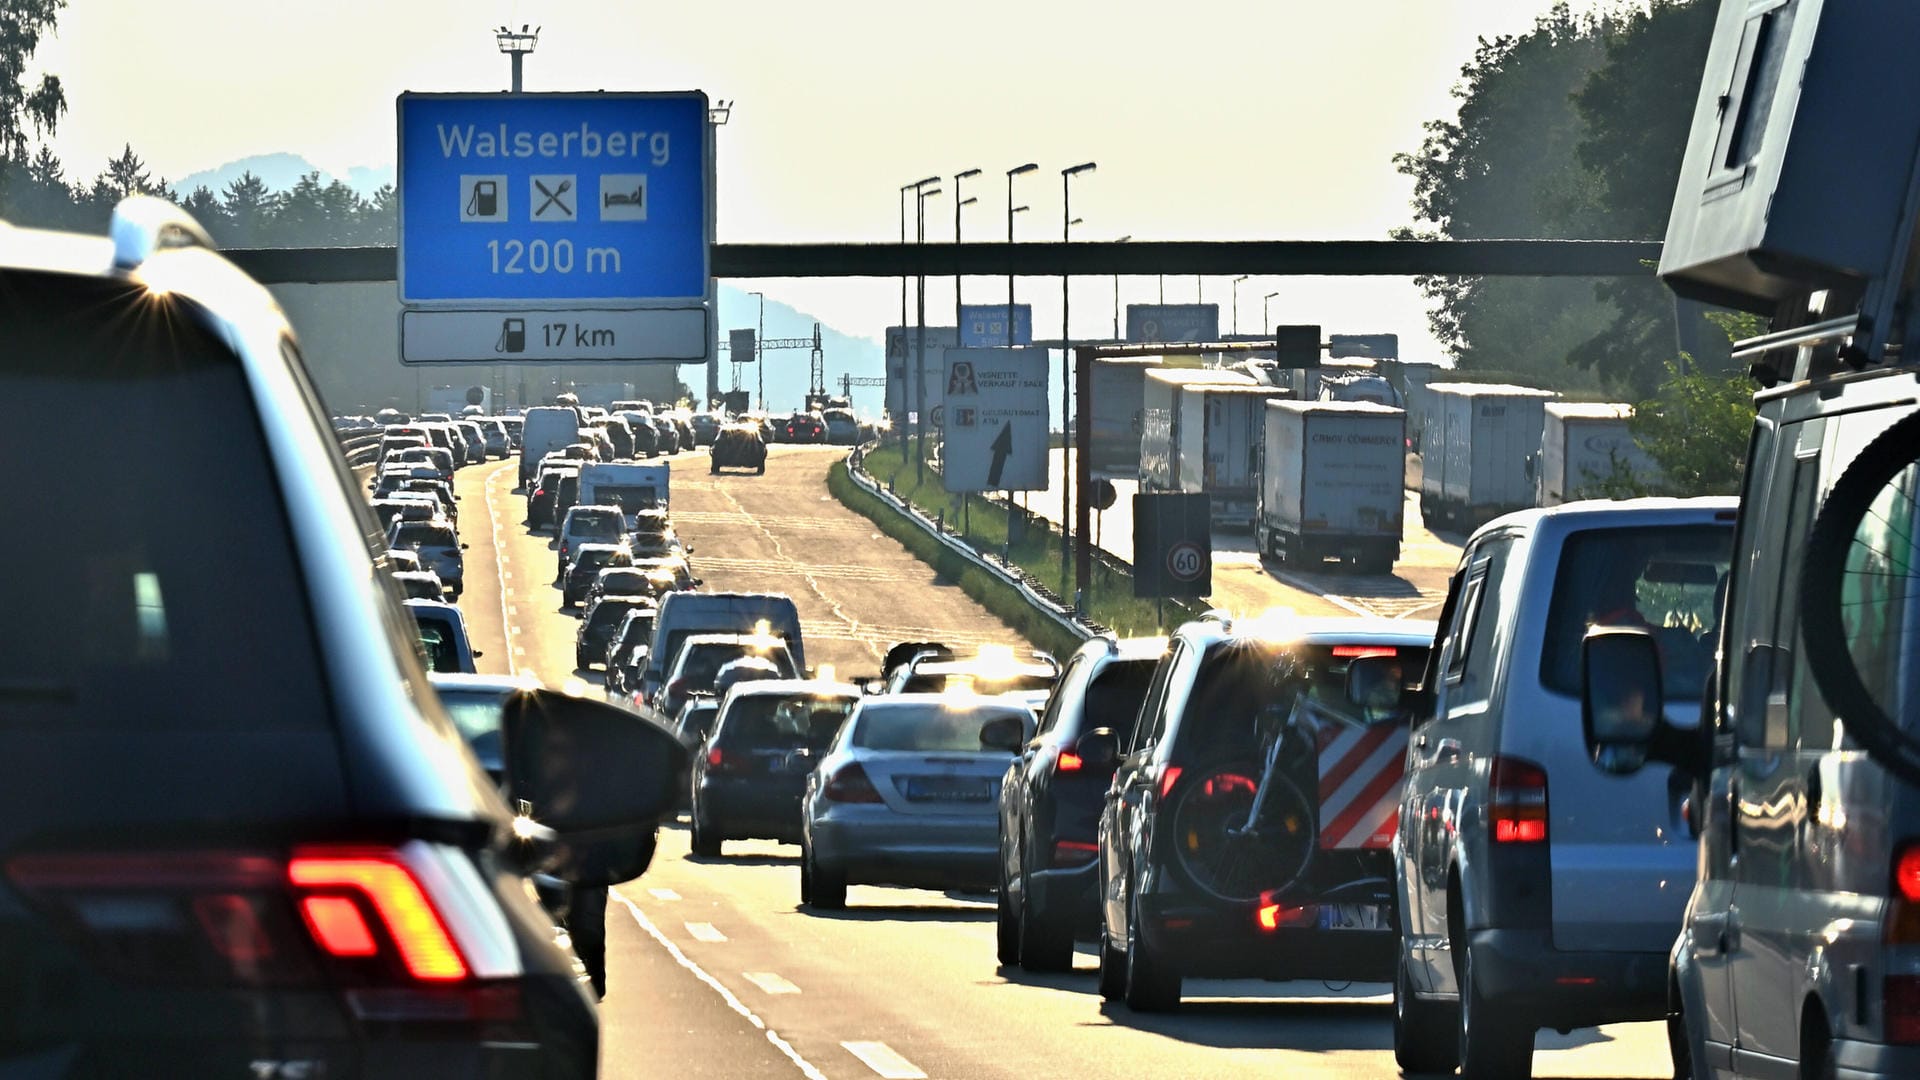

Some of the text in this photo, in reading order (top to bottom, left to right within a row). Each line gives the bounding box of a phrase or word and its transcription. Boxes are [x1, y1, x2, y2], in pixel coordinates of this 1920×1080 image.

[437, 122, 670, 166] Walserberg
[487, 239, 621, 274] 1200 m
[542, 324, 615, 347] 17 km
[977, 371, 1018, 379] VIGNETTE
[977, 379, 1015, 388] VERKAUF
[982, 409, 1041, 417] GELDAUTOMAT
[982, 417, 999, 425] ATM
[1176, 553, 1197, 570] 60
